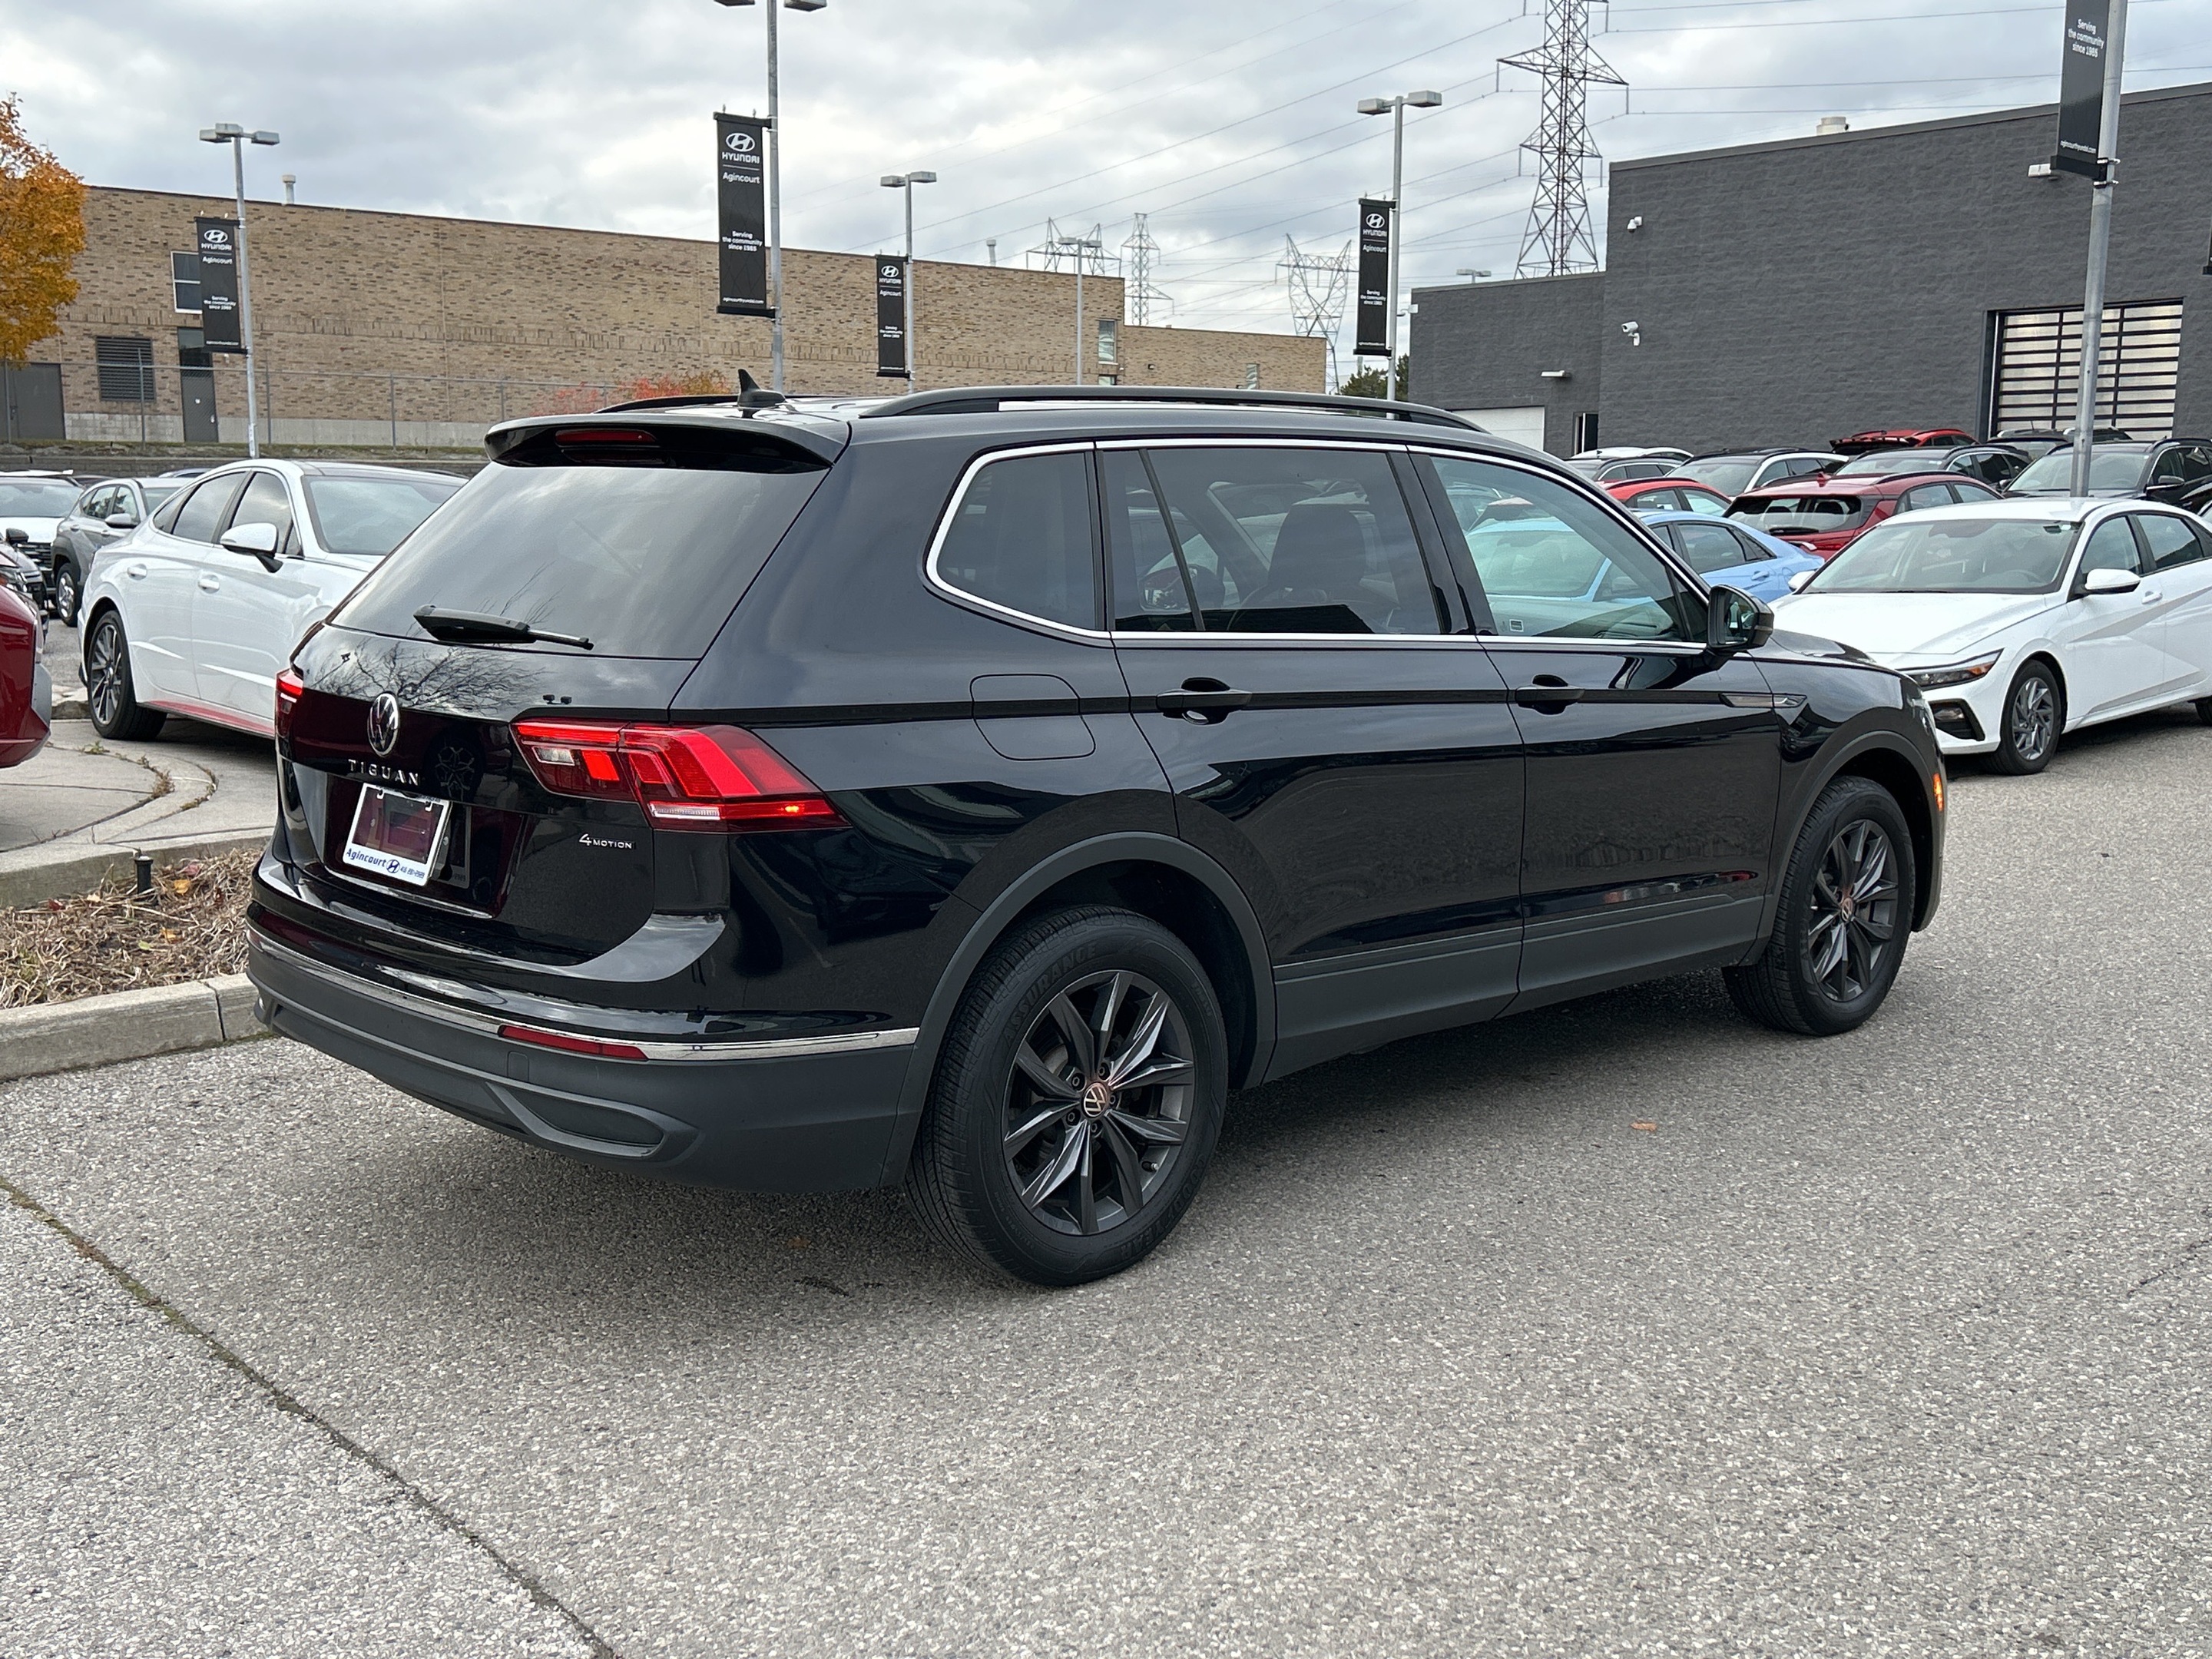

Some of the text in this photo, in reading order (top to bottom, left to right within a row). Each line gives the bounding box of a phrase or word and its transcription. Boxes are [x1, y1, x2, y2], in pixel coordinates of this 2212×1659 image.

[2078, 18, 2096, 35] Serving
[2068, 28, 2104, 49] the community
[2072, 41, 2085, 54] since
[722, 151, 760, 164] HYUNDAI
[722, 172, 760, 184] Agincourt
[732, 230, 753, 239] Serving
[1363, 229, 1387, 237] HYUNDAI
[201, 243, 232, 251] HYUNDAI
[732, 238, 763, 247] community
[1363, 244, 1387, 253] Agincourt
[202, 256, 233, 265] Agincourt
[348, 759, 419, 786] TIGUAN
[578, 833, 632, 849] 4MOTION
[346, 848, 386, 867] Agincourt
[1004, 942, 1097, 1048] ASSURANCE
